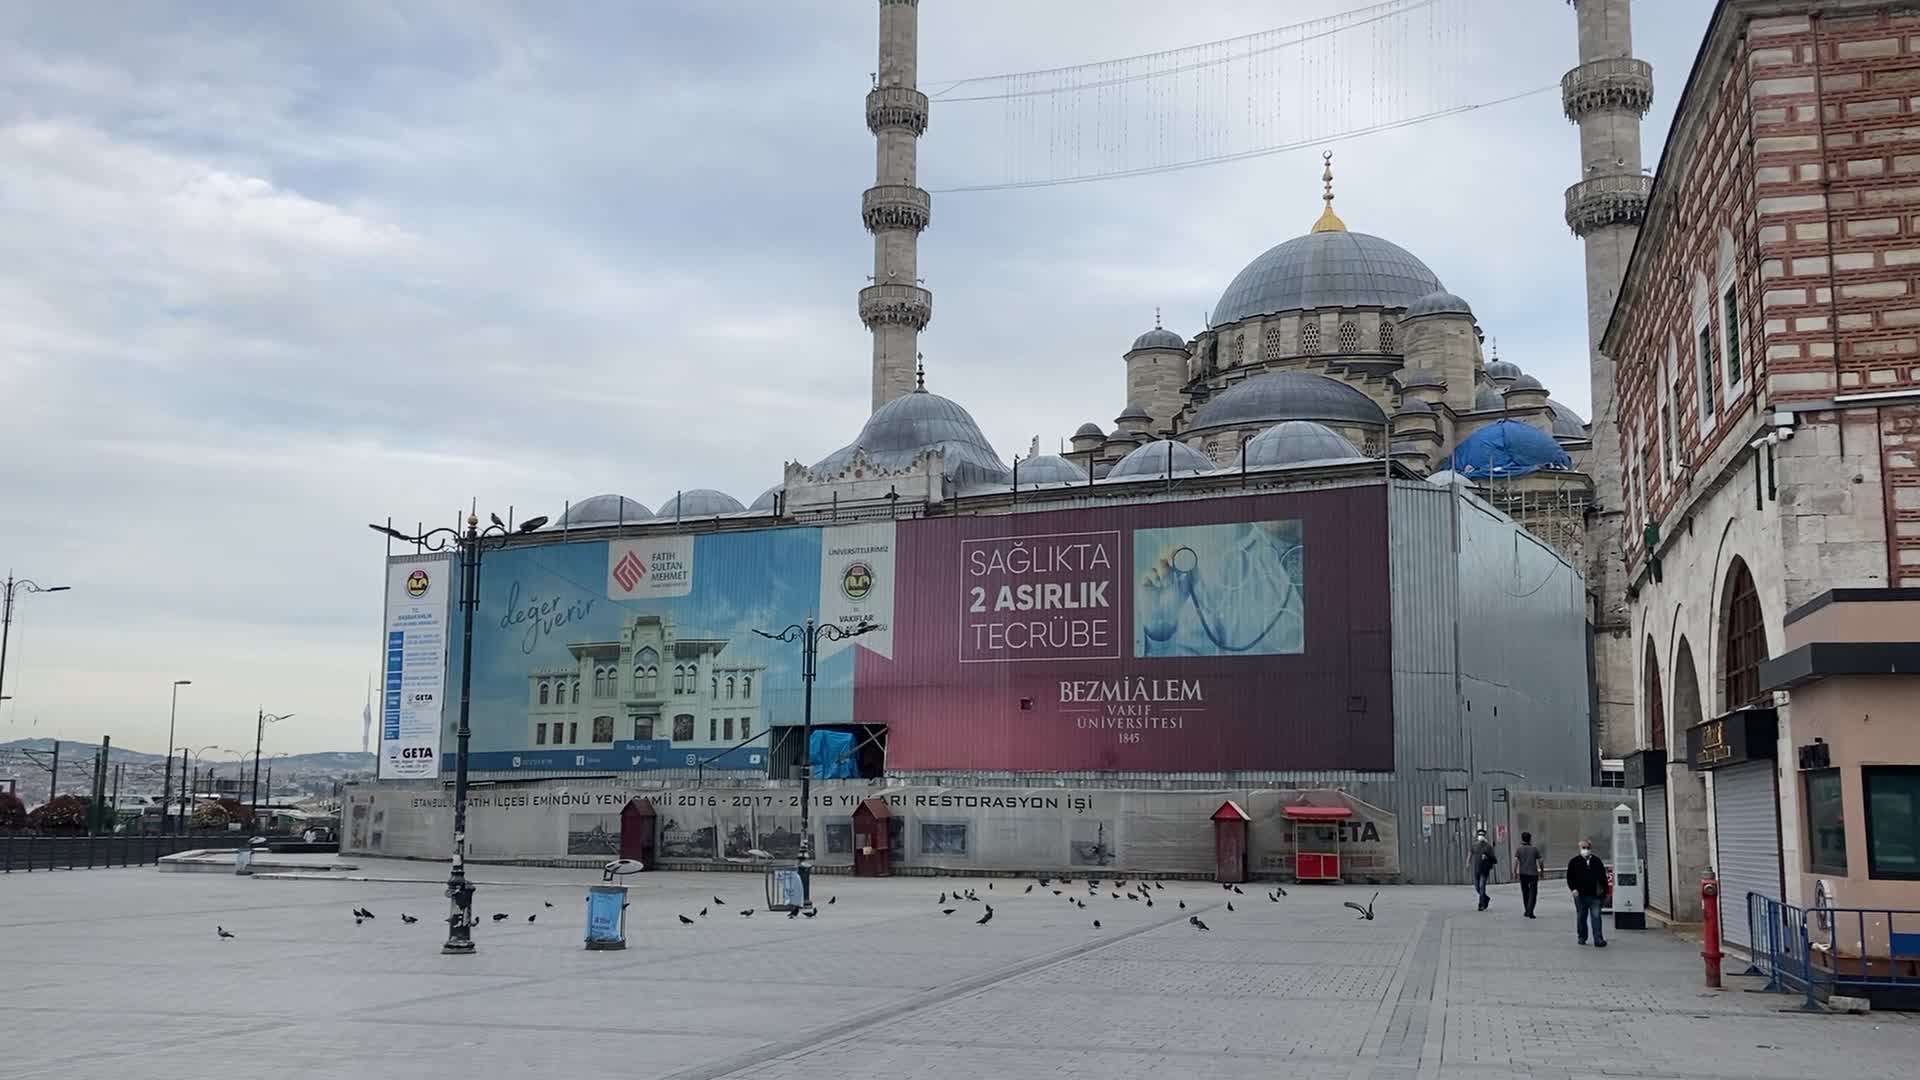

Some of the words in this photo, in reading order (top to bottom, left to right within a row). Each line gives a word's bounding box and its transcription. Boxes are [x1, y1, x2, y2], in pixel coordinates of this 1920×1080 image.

[651, 561, 683, 572] SULTAN
[970, 541, 1111, 576] SAĞLIKTA
[651, 570, 689, 581] MEHMET
[969, 586, 987, 613] 2
[994, 581, 1110, 612] ASIRLIK
[501, 580, 561, 655] değer
[543, 598, 597, 635] verir
[970, 616, 1108, 650] TECRÜBE
[1059, 676, 1204, 703] BEZMİÂLEM
[1107, 704, 1152, 716] VAKIF
[1077, 716, 1183, 729] ÜNİVERSİTESİ
[1119, 733, 1140, 743] 1845
[402, 747, 433, 758] GETA
[595, 791, 627, 805] YENİ
[678, 795, 717, 806] 2016
[732, 796, 772, 806] 2017
[790, 795, 833, 806] 218
[915, 795, 1058, 808] RESTORASYON
[1067, 794, 1093, 813] İŞİ
